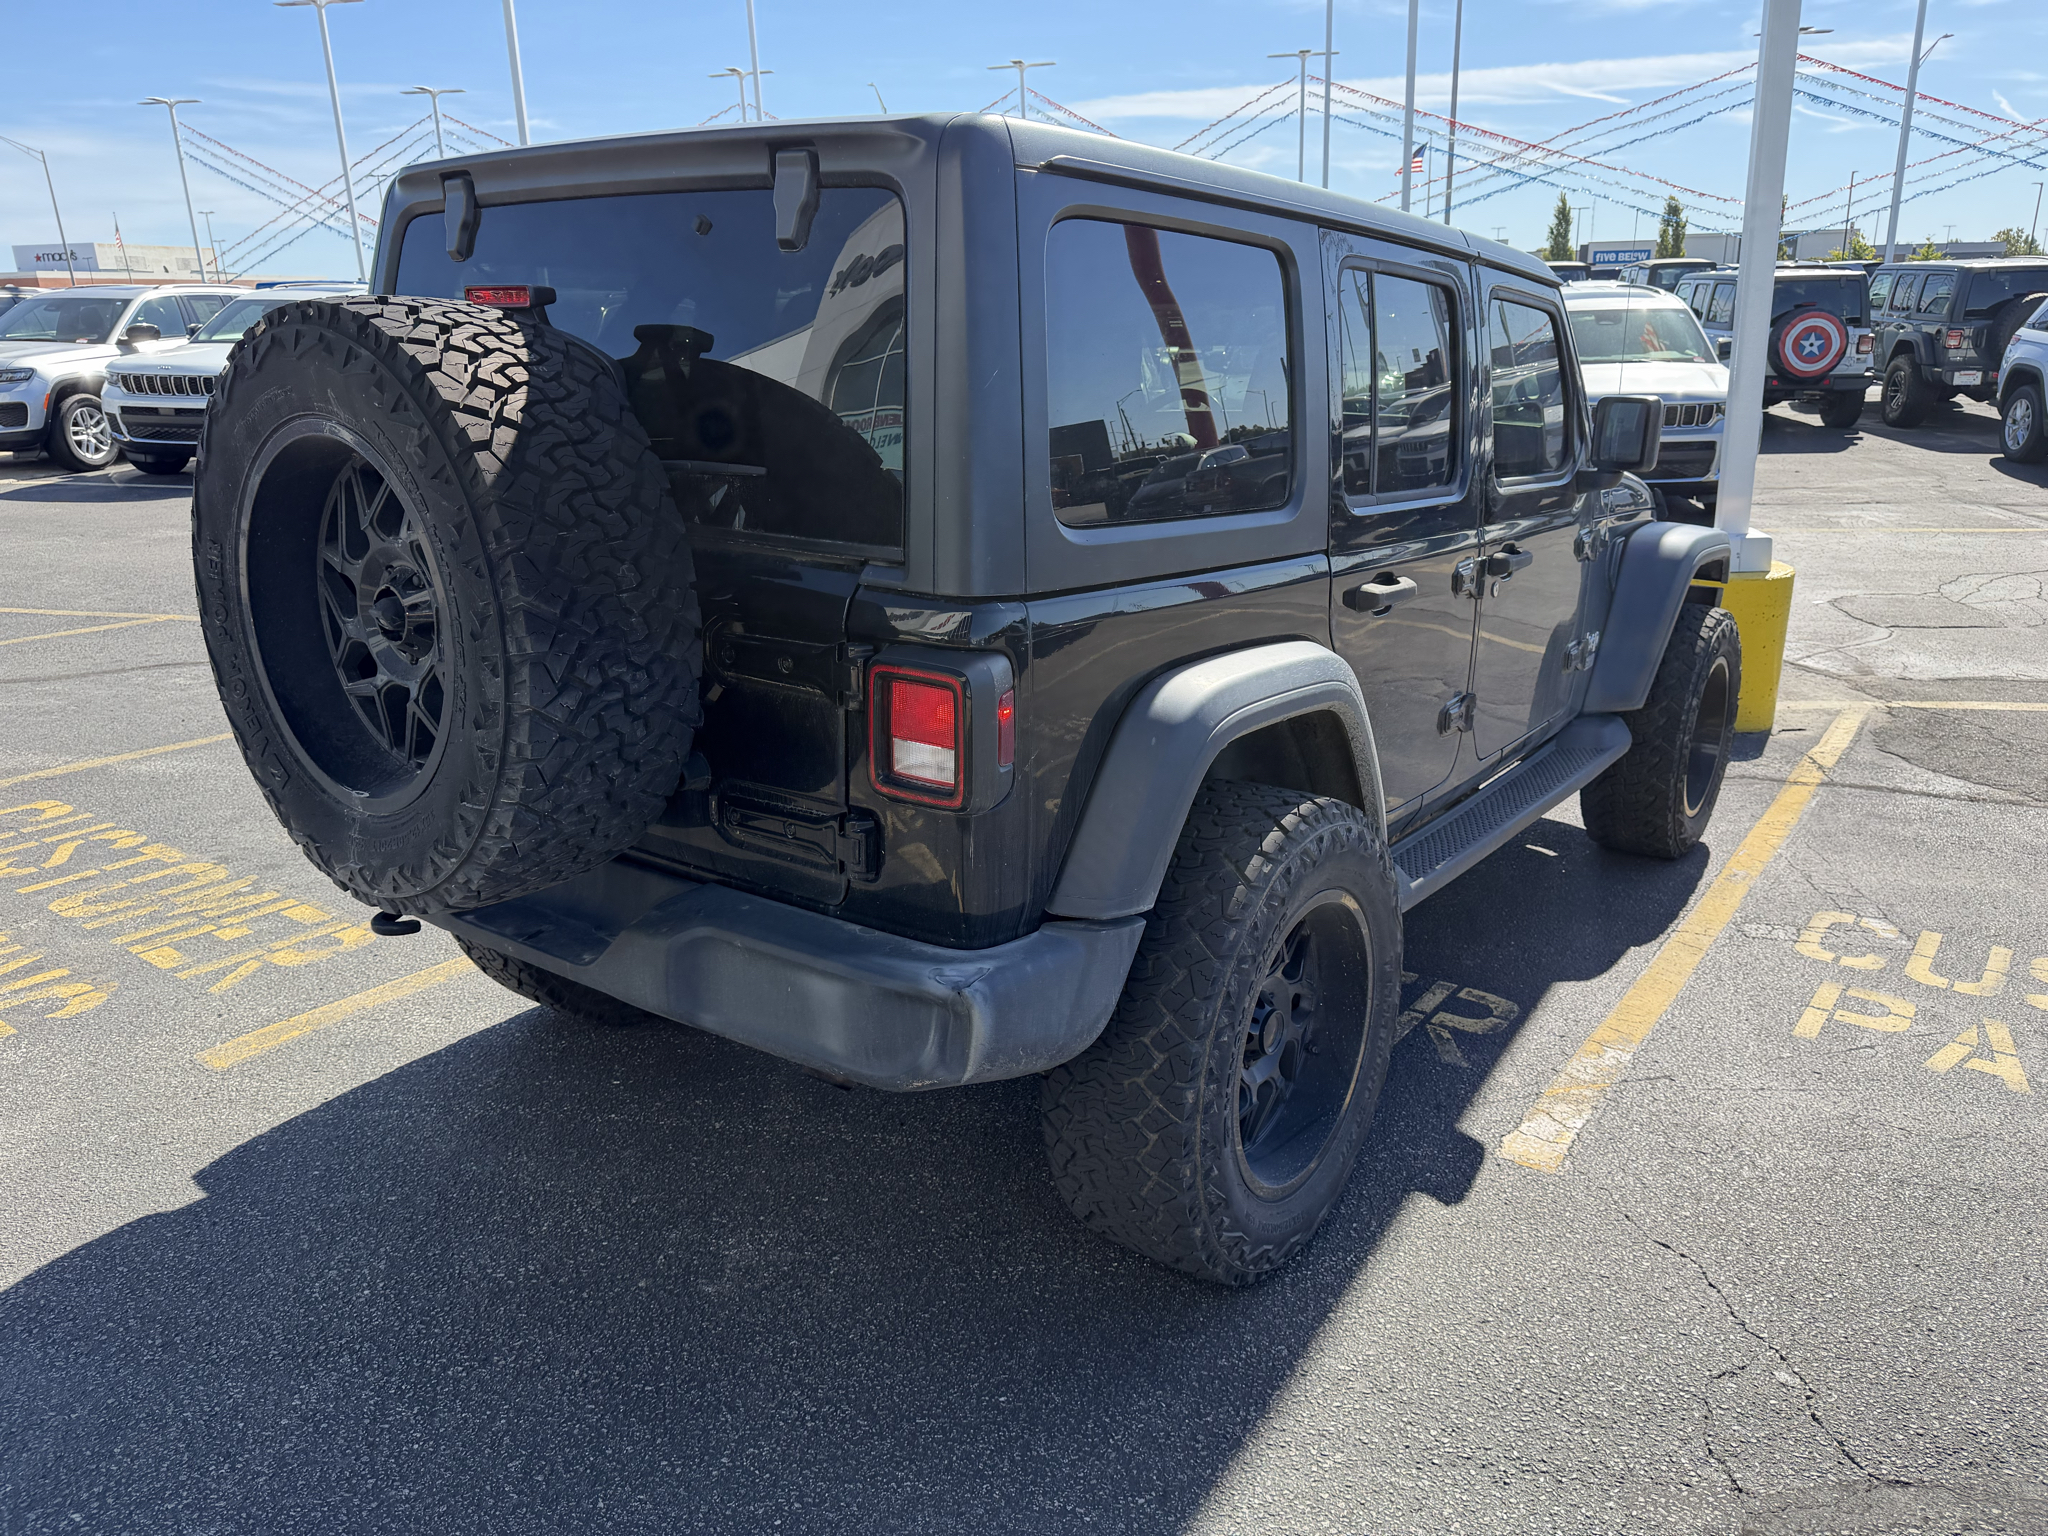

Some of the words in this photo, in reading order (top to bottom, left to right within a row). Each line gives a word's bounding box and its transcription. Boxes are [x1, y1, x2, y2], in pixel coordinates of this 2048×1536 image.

[1595, 252, 1617, 262] five
[1617, 251, 1649, 262] BELOW
[1794, 911, 2048, 1011] CU
[1792, 981, 2031, 1094] PA
